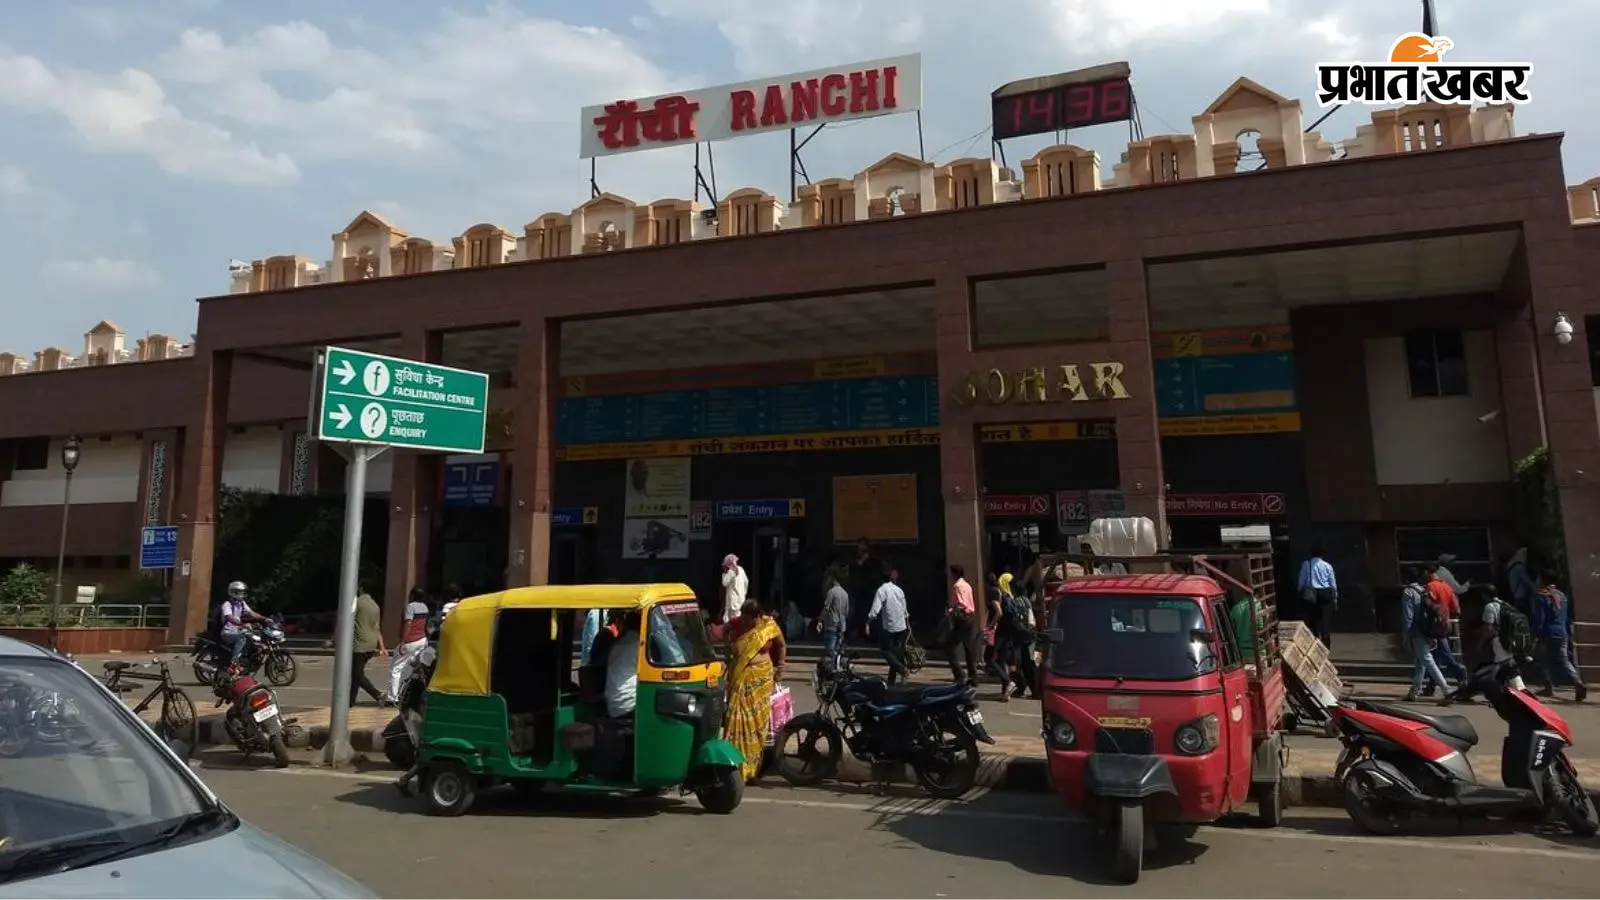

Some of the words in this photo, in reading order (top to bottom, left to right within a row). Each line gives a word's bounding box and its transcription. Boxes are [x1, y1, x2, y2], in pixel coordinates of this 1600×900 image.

[730, 66, 897, 131] RANCHI
[394, 367, 423, 385] सुविधा
[393, 386, 446, 402] FACILITATION
[446, 394, 475, 405] CENTRE
[391, 409, 424, 425] पूछताछ
[389, 426, 427, 438] ENQUIRY
[748, 503, 775, 517] Entry
[989, 501, 1002, 510] No
[1003, 501, 1027, 512] Entry
[1060, 502, 1086, 520] 182
[1215, 501, 1228, 510] No
[1231, 501, 1258, 511] Entry
[691, 511, 711, 530] 182
